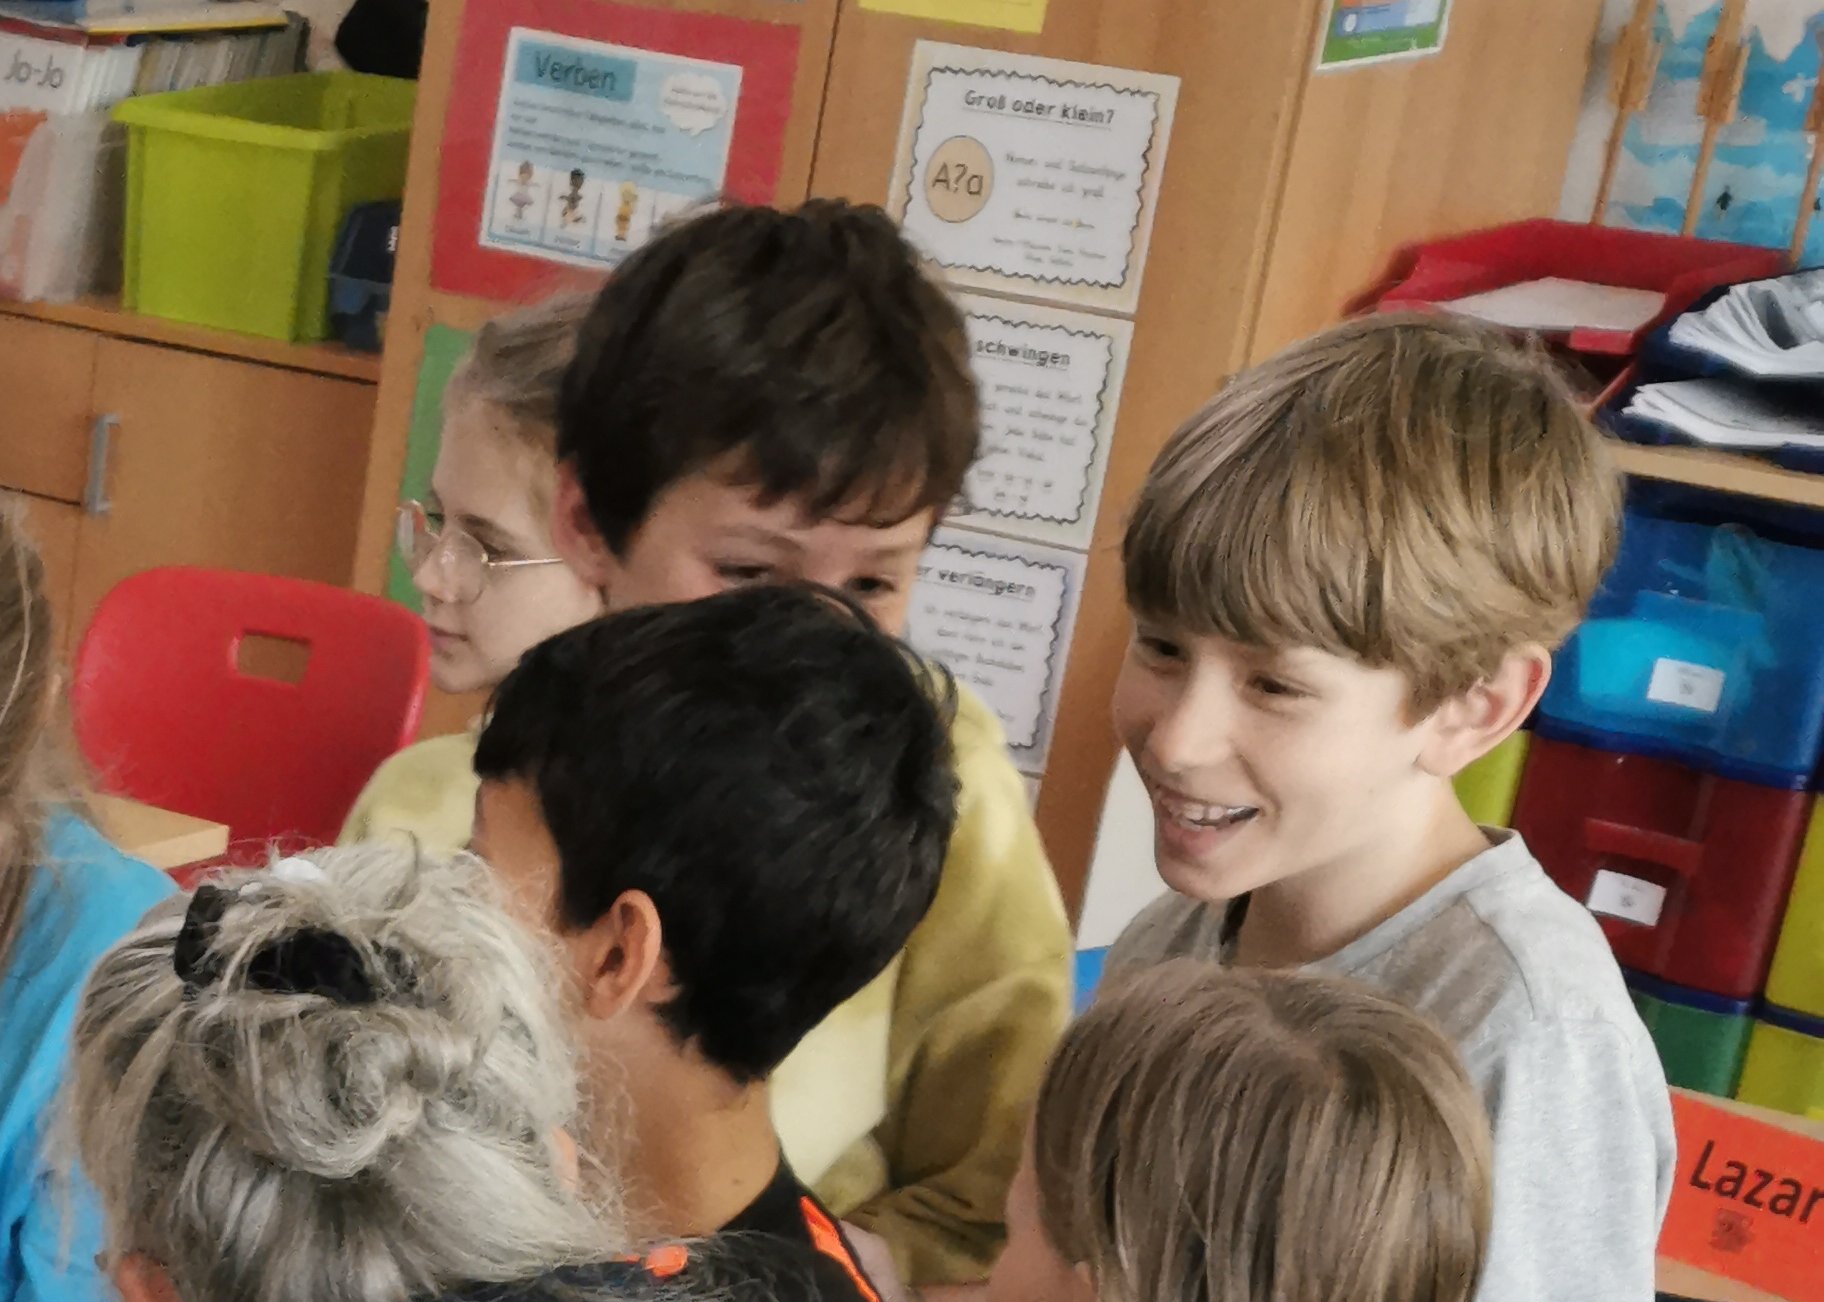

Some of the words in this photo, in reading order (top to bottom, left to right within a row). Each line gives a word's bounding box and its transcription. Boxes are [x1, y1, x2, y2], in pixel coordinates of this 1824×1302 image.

[4, 50, 64, 89] Jo-Jo
[534, 51, 616, 92] Verben
[1011, 97, 1056, 116] oder
[1689, 1138, 1824, 1225] Lazar
